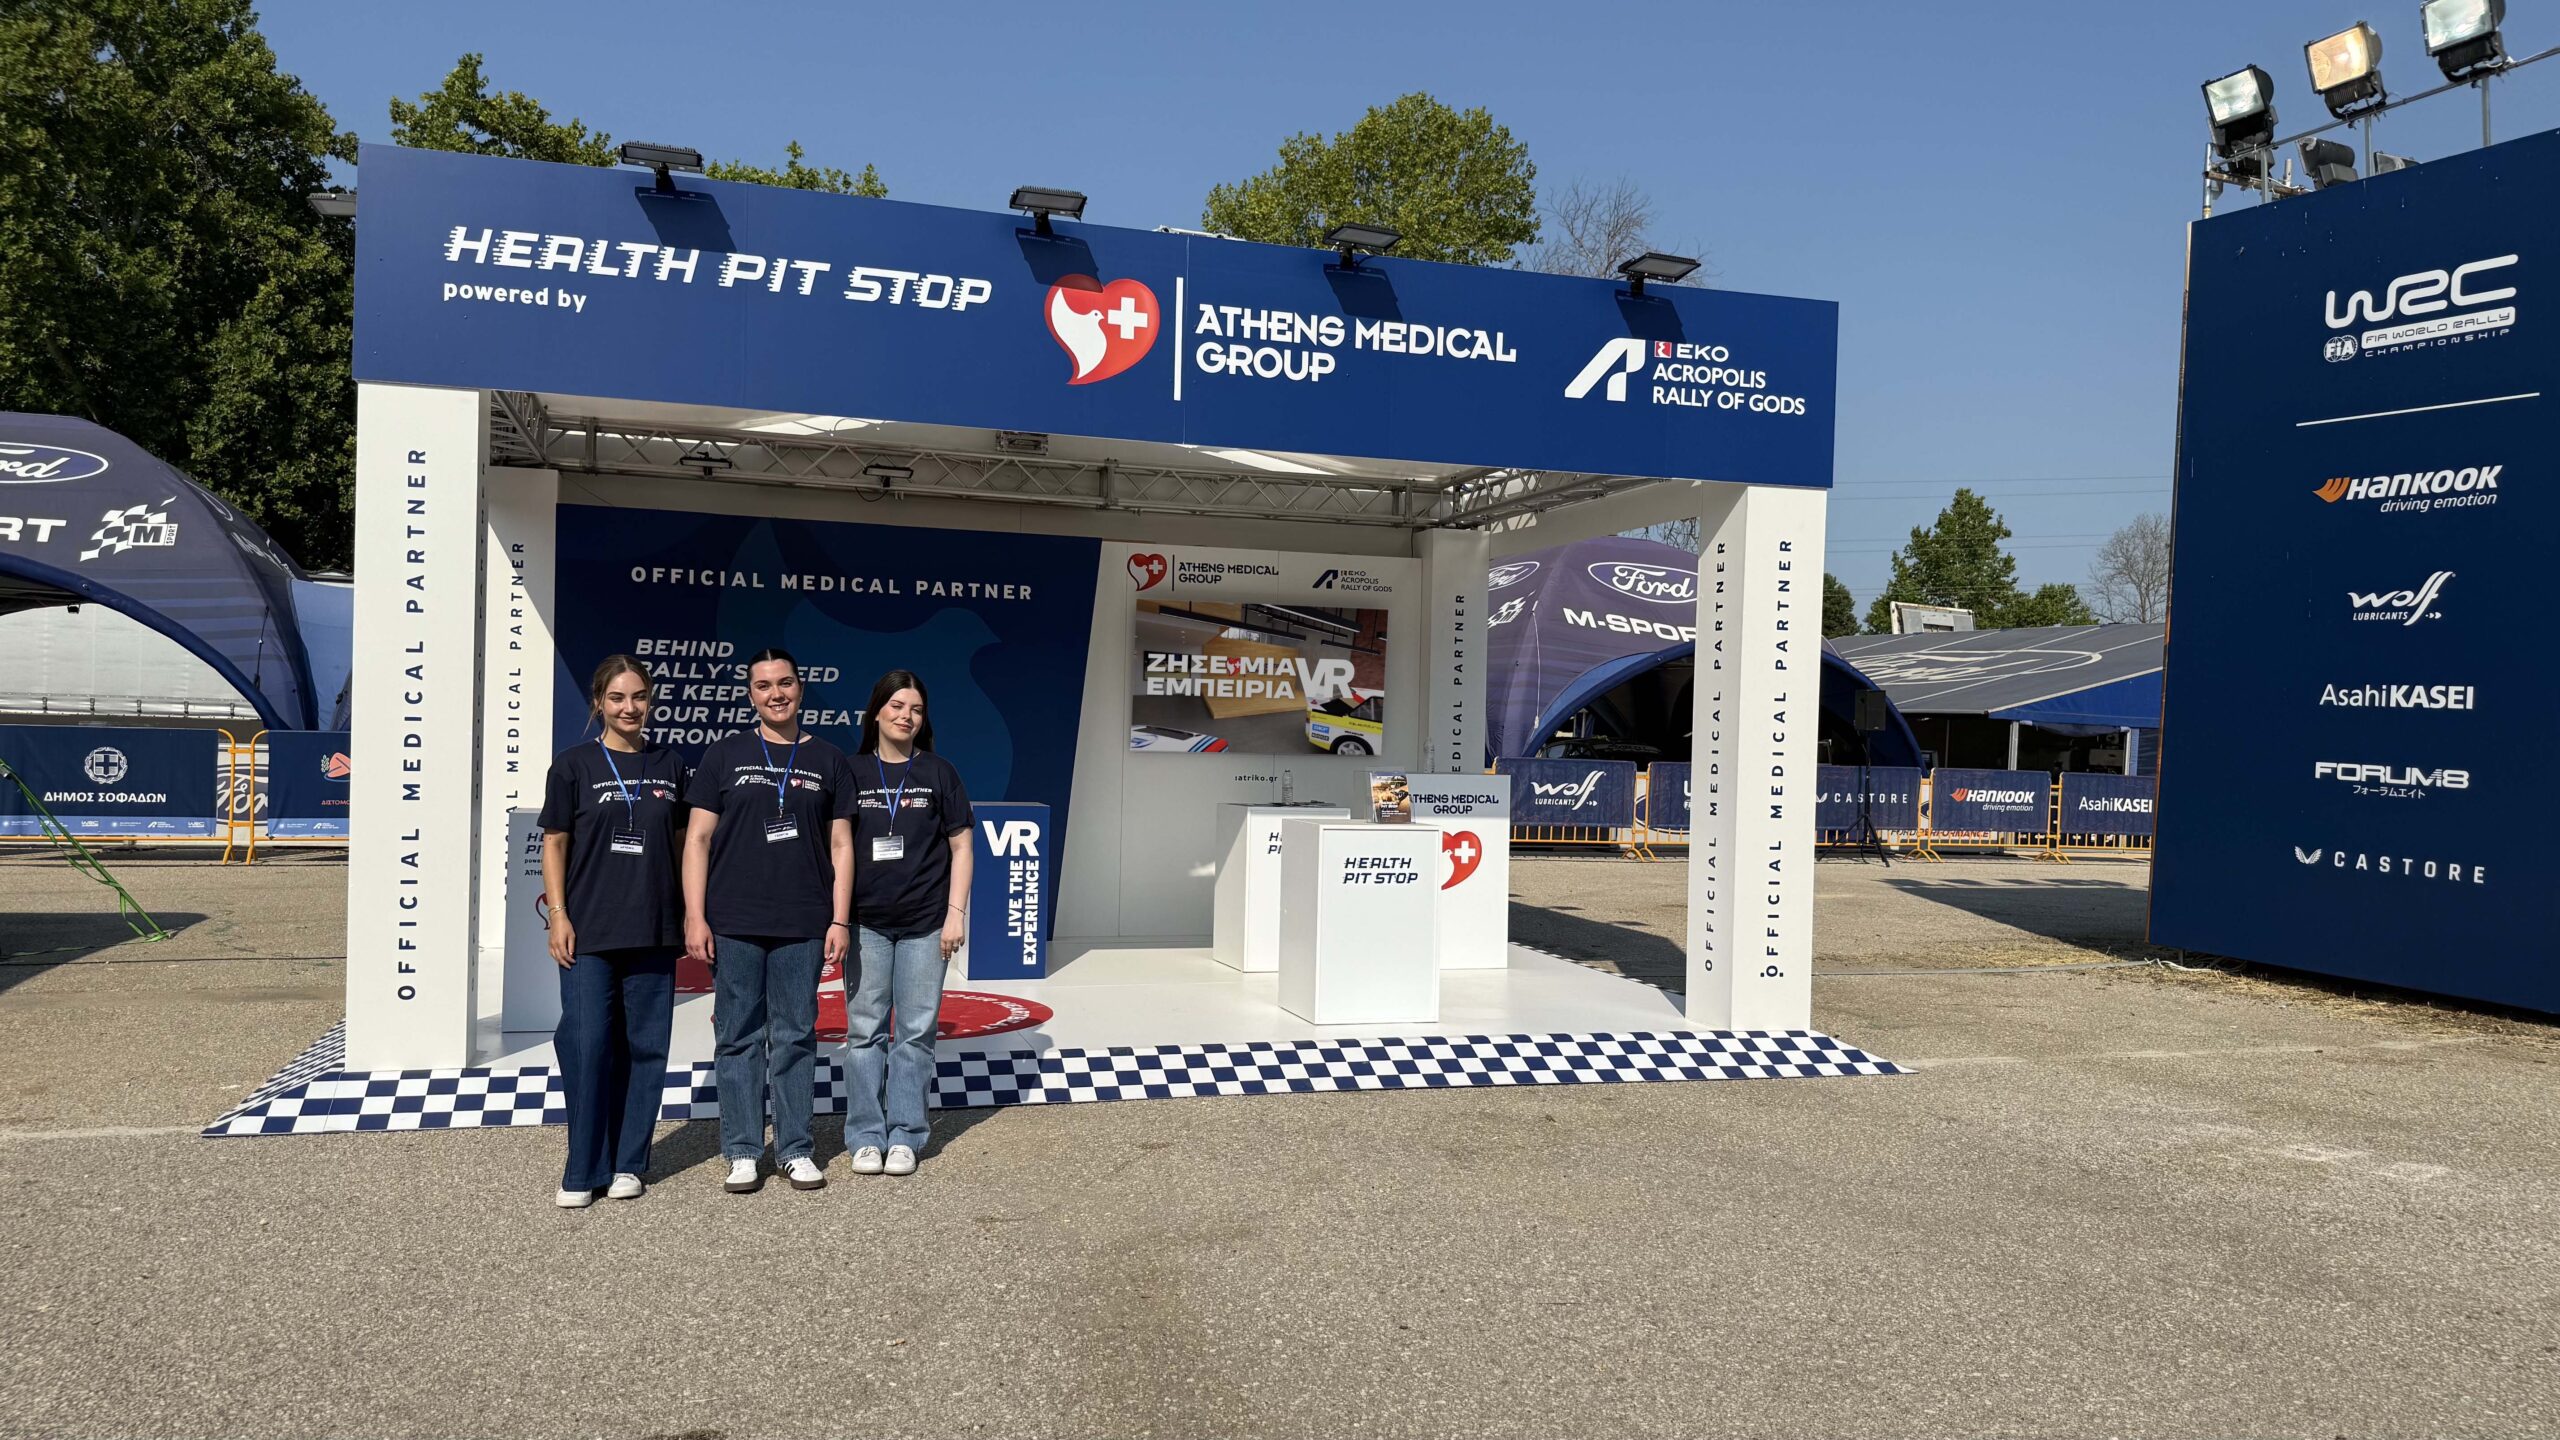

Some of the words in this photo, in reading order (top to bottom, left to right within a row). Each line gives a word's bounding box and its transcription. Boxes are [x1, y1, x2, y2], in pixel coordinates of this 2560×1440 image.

[444, 226, 700, 283] HEALTH
[718, 253, 831, 295] PIT
[843, 266, 992, 311] STOP
[444, 283, 549, 305] powered
[558, 289, 587, 313] by
[2325, 254, 2519, 329] WRC
[1195, 303, 1345, 347] ATHENS
[1355, 318, 1517, 362] MEDICAL
[2365, 328, 2510, 358] CHAMPIONSHIP
[2366, 334, 2388, 344] FIA
[2393, 323, 2447, 340] WORLD
[2452, 312, 2510, 329] RALLY
[1196, 342, 1336, 382] GROUP
[1676, 343, 1729, 362] EKO
[1653, 363, 1766, 388] ACROPOLIS
[1653, 386, 1713, 408] RALLY
[1717, 391, 1745, 410] OF
[1749, 396, 1805, 415] GODS
[2380, 499, 2430, 513] driving
[2433, 493, 2497, 509] emotion
[406, 450, 426, 613] PARTNER
[631, 566, 764, 588] OFFICIAL
[781, 574, 900, 594] MEDICAL
[915, 580, 1032, 600] PARTNER
[1178, 561, 1224, 574] ATHENS
[1227, 564, 1279, 576] MEDICAL
[1178, 573, 1222, 584] GROUP
[1341, 577, 1379, 585] ACROPOLIS
[1612, 564, 1694, 598] Ford
[509, 543, 524, 650] PARTNER
[1372, 585, 1392, 593] GODS
[1714, 542, 1726, 670] PARTNER
[1775, 540, 1792, 671] PARTNER
[2353, 611, 2408, 621] LUBRICANTS
[635, 638, 734, 658] BEHIND
[1453, 595, 1465, 686] PARTNER
[1147, 653, 1227, 675] ΖΗΣΕ
[1239, 656, 1297, 677] ΜΙΑ
[1295, 657, 1355, 699] VR
[682, 684, 749, 701] KEEP
[1146, 676, 1295, 699] ΕΜΠΕΙΡΙΑ
[402, 640, 424, 801] MEDICAL
[506, 667, 521, 773] MEDICAL
[649, 705, 710, 723] OUR
[640, 728, 741, 744] STRON
[1452, 701, 1463, 773] EDICAL
[1710, 691, 1721, 816] MEDICAL
[1770, 692, 1787, 819] MEDICAL
[2315, 761, 2469, 789] FORUM8
[43, 791, 95, 802] ΔΗΜΟΣ
[98, 791, 167, 803] ΣΟΦΑΔΩΝ
[1451, 795, 1499, 805] MEDICAL
[1535, 797, 1575, 806] LUBRICANTS
[1834, 793, 1908, 805] CASTORE
[2352, 785, 2426, 799] フォーラムエイト
[1433, 805, 1473, 815] GROUP
[1982, 803, 2004, 813] driving
[2006, 804, 2034, 812] emotion
[982, 820, 1041, 857] VR
[1009, 860, 1024, 894] THE
[1342, 873, 1371, 884] PIT
[1374, 873, 1418, 884] STOP
[1344, 858, 1412, 869] HEALTH
[2334, 851, 2485, 884] CASTORE
[397, 828, 420, 1001] OFFICIAL
[1008, 898, 1023, 937] LIVE
[1023, 860, 1039, 965] EXPERIENCE
[1705, 837, 1717, 972] OFFICIAL
[1765, 840, 1782, 978] OFFICIAL
